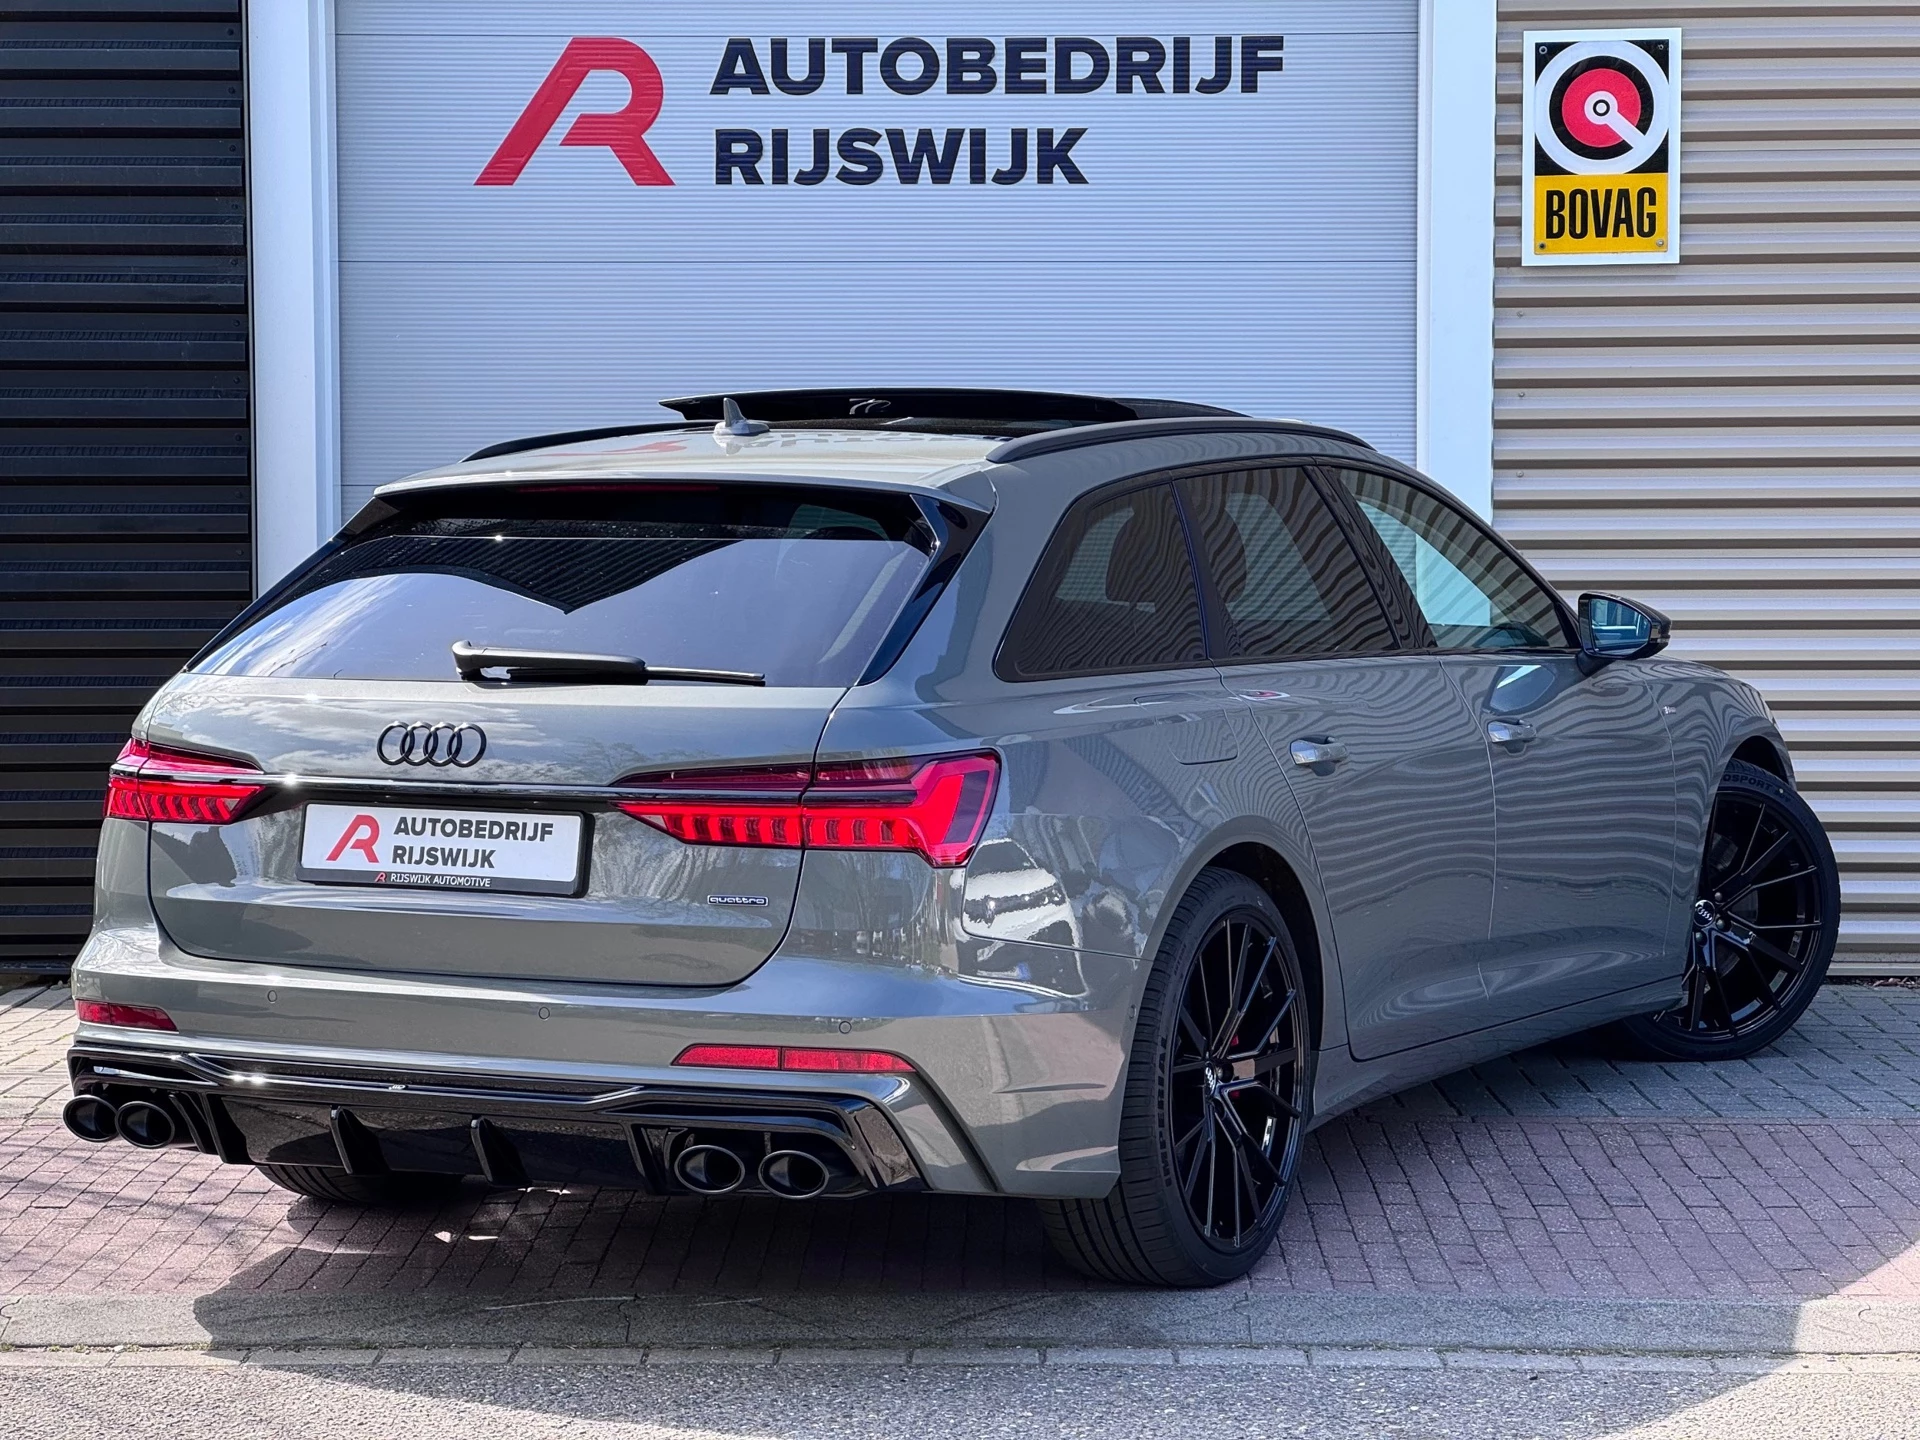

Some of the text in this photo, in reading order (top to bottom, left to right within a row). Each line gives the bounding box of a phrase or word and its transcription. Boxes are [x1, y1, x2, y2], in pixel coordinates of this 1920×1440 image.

[709, 35, 1284, 95] AUTOBEDRIJF
[714, 127, 1089, 185] RIJSWIJK
[1545, 187, 1657, 239] BOVAG
[393, 816, 554, 842] AUTOBEDRIJF
[392, 845, 496, 869] RIJSWIJK
[390, 873, 431, 884] RIJSWIJK
[433, 875, 491, 887] AUTOMOTIVE
